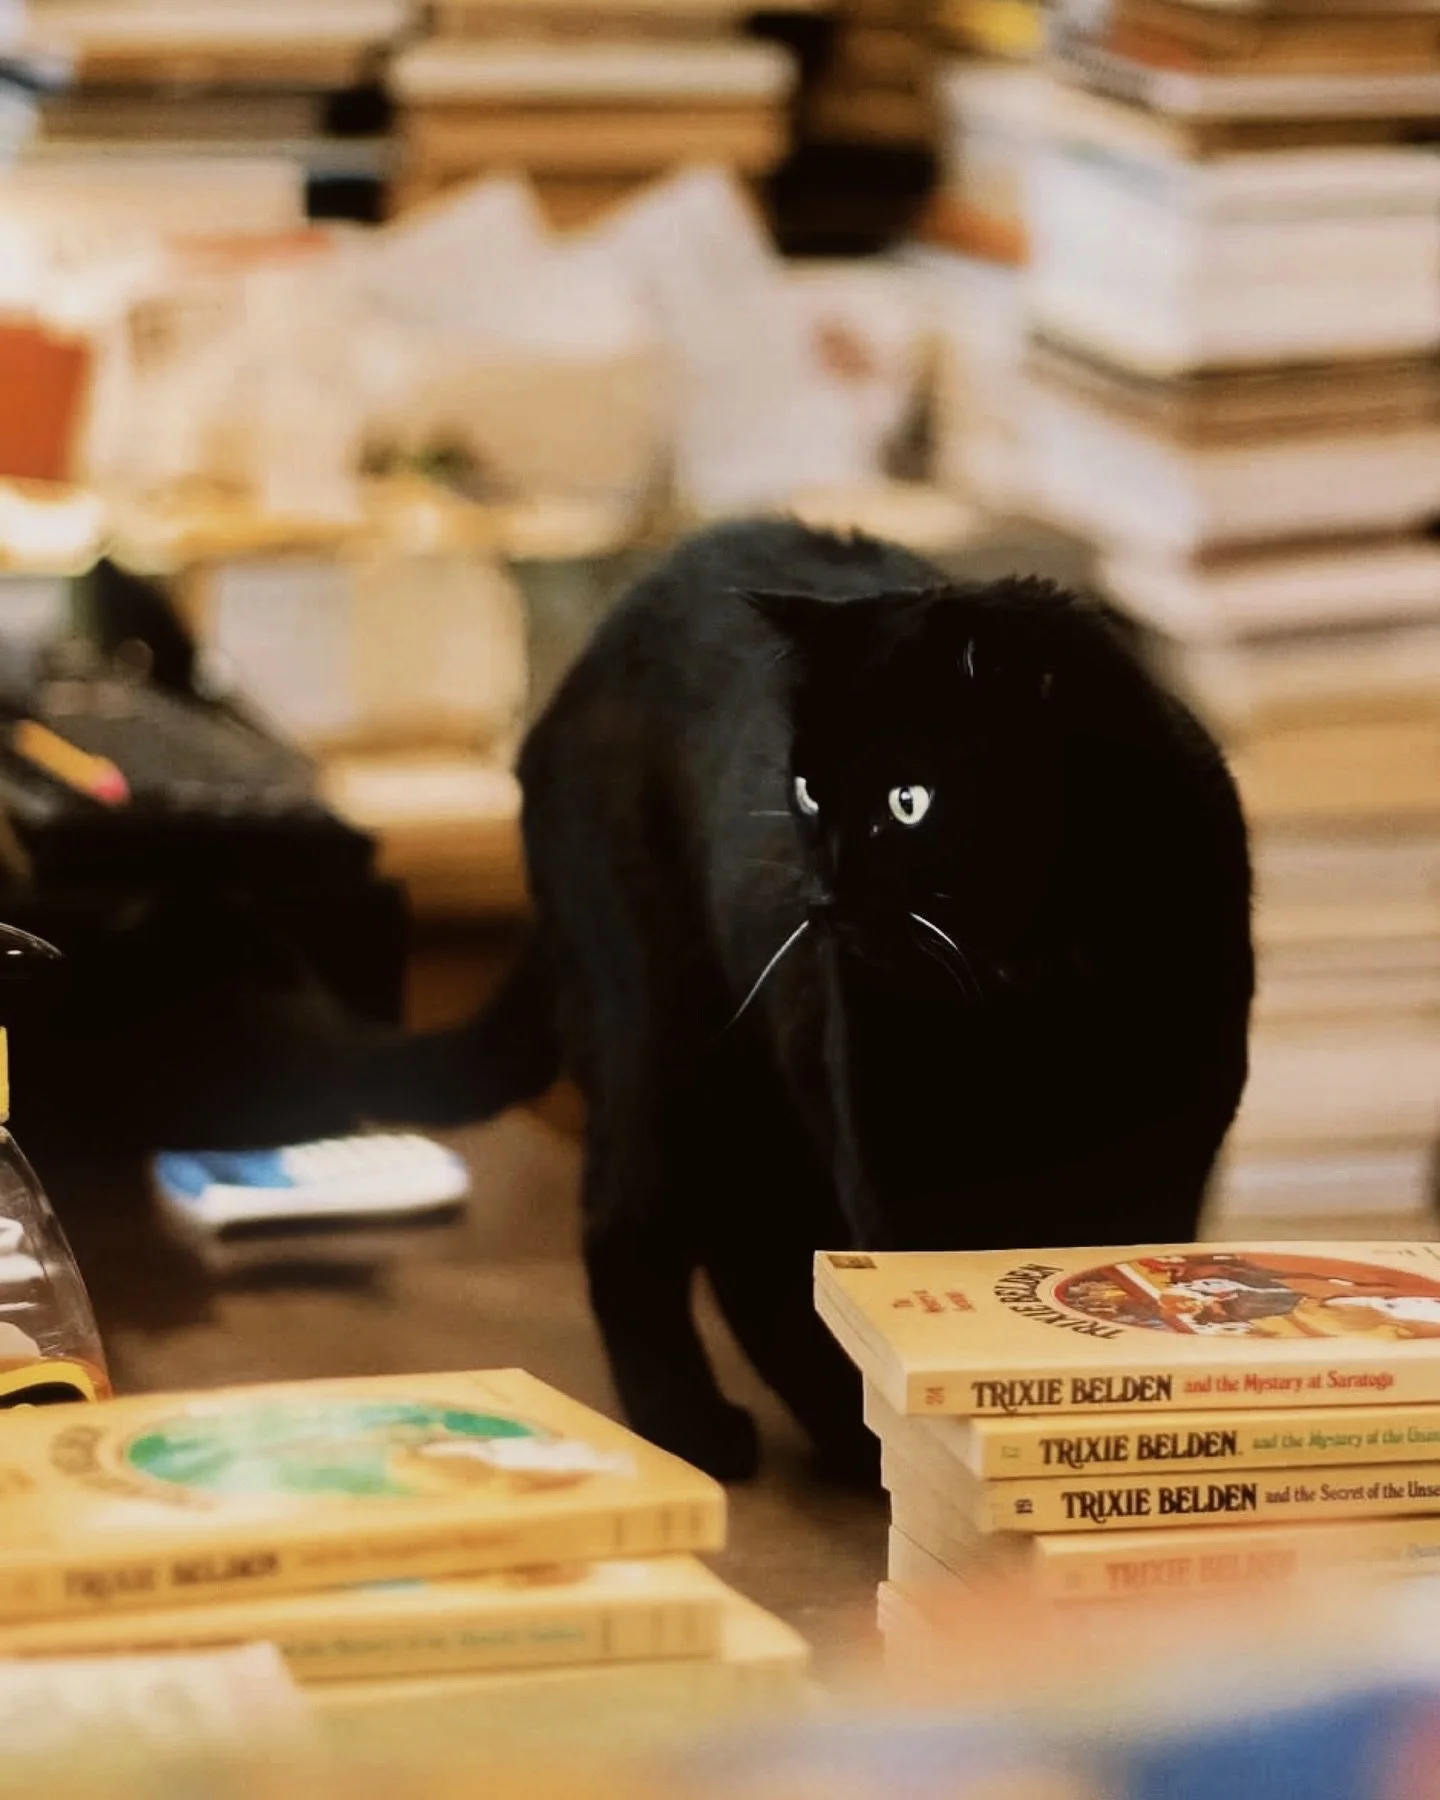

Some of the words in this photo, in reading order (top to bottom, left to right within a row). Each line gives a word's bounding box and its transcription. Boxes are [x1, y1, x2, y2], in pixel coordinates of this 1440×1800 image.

[993, 1263, 1064, 1303] BELDEN
[1008, 1304, 1125, 1340] TRIXIE
[971, 1378, 1064, 1414] TRIXIE
[1070, 1374, 1172, 1404] BELDEN
[1184, 1376, 1211, 1393] and
[1216, 1376, 1240, 1393] the
[1244, 1373, 1302, 1394] Mystery
[1307, 1373, 1322, 1389] at
[1327, 1370, 1394, 1390] Saratoga
[1039, 1434, 1129, 1469] TRIXIE
[1061, 1488, 1151, 1524] TRIXIE
[1157, 1483, 1257, 1514] BELDEN
[1265, 1486, 1290, 1503] and
[1294, 1486, 1316, 1502] the
[1321, 1484, 1364, 1501] Secret
[1367, 1482, 1379, 1499] of
[1383, 1482, 1404, 1499] the
